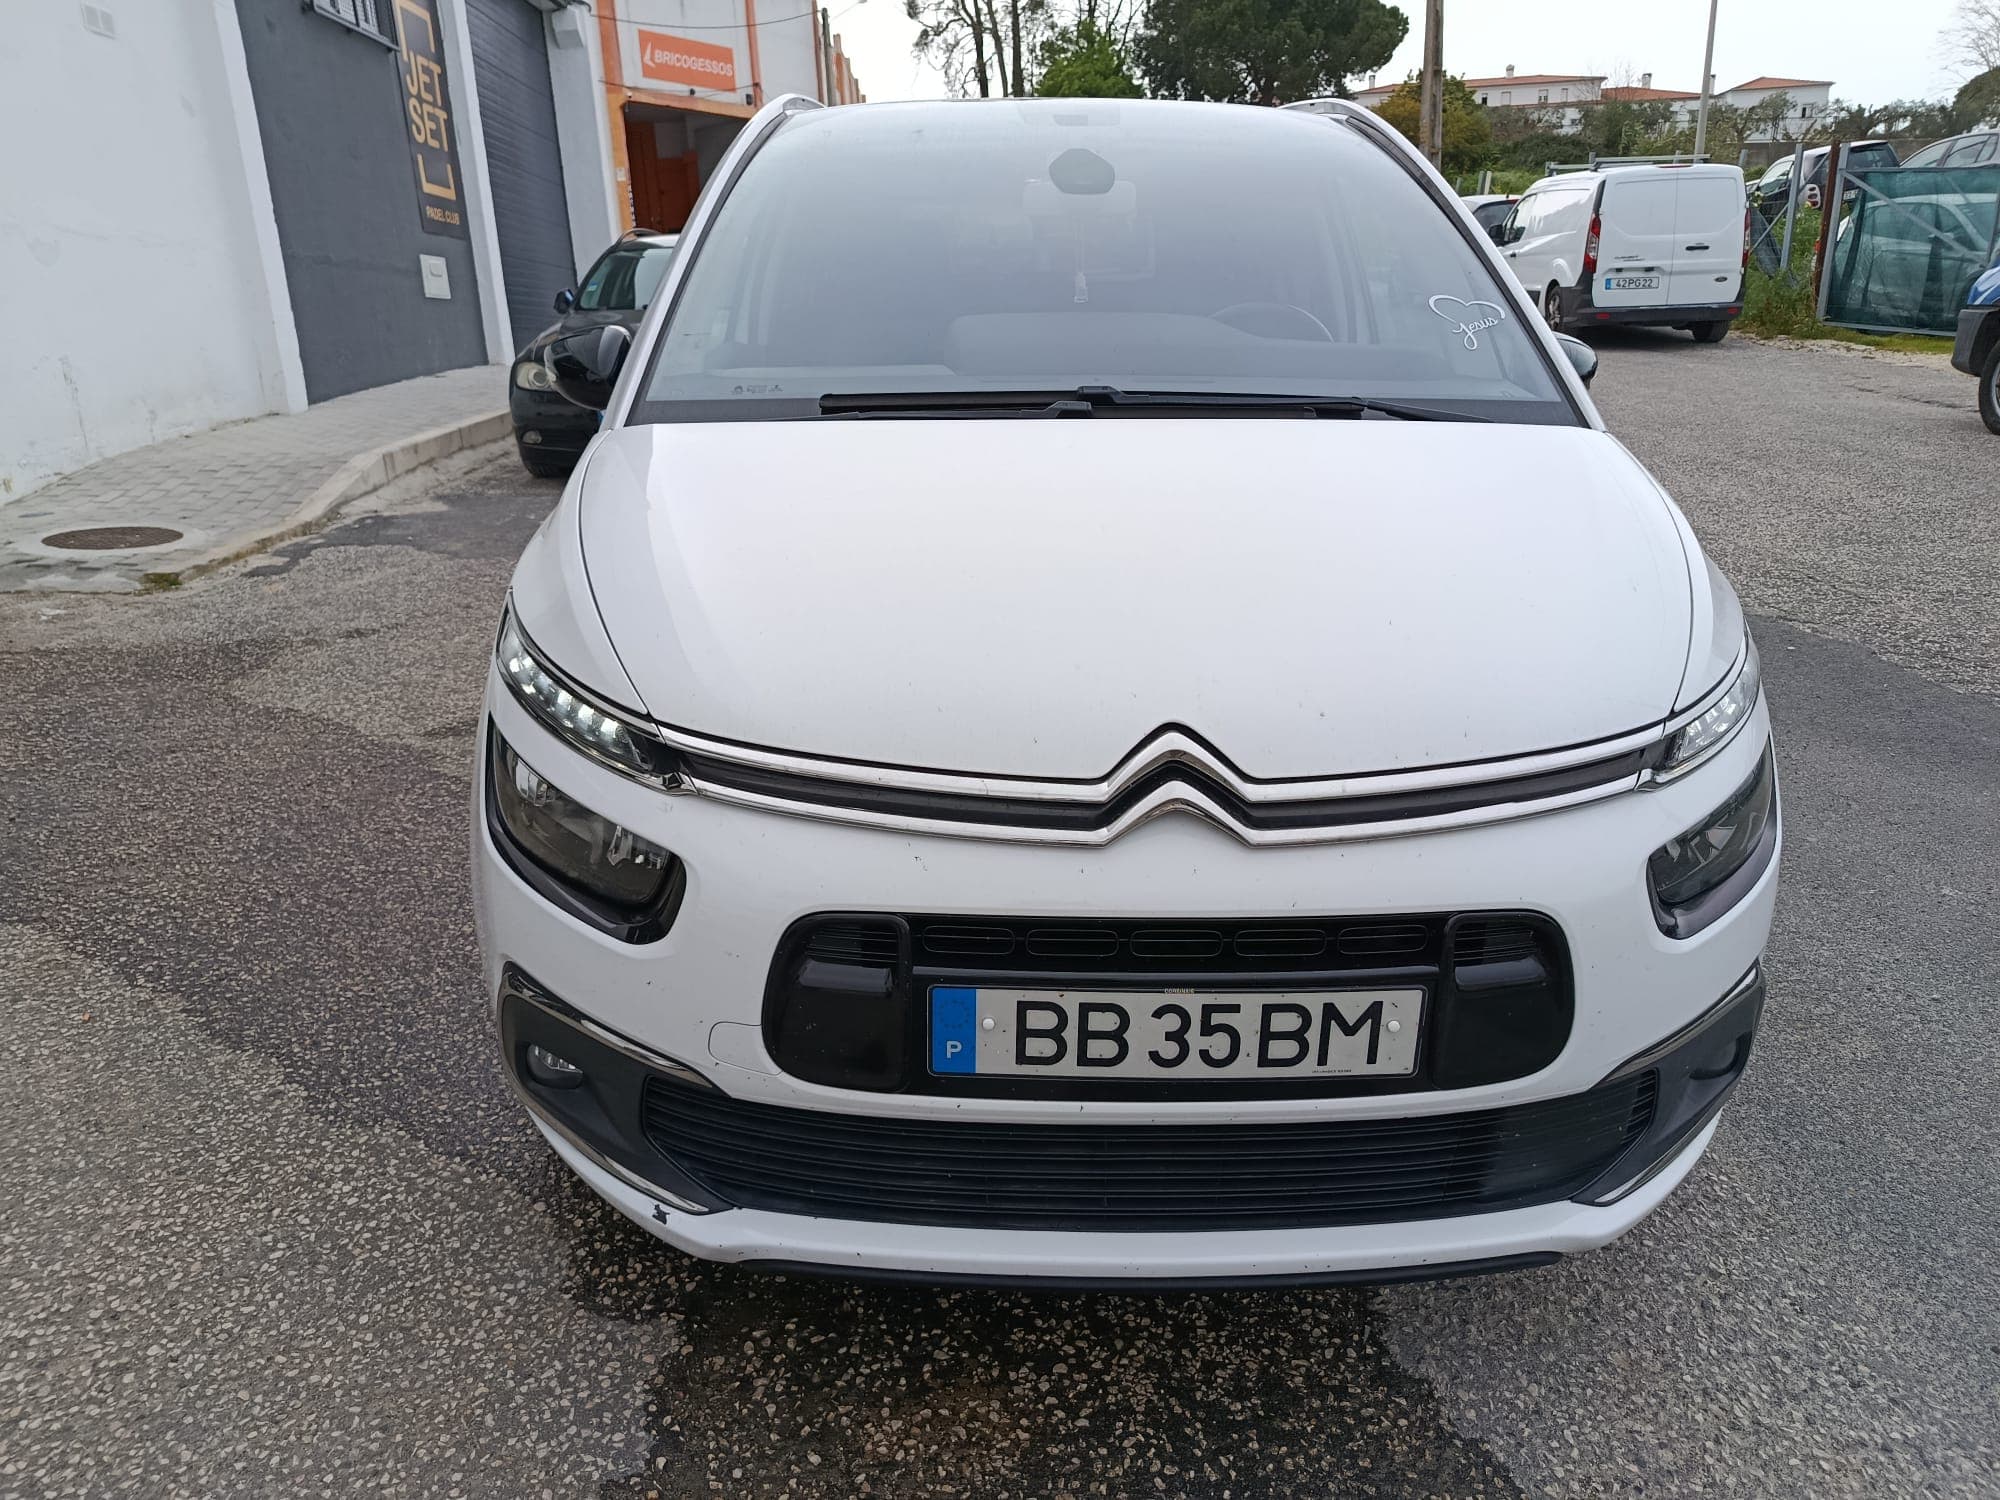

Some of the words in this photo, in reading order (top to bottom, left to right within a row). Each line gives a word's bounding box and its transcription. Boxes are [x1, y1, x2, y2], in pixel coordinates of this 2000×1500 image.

[406, 50, 442, 106] JET
[654, 48, 733, 77] BRICOGESSOS
[408, 97, 449, 152] SET
[426, 205, 445, 221] PADEL
[946, 1040, 962, 1058] P
[1015, 1000, 1131, 1067] BB
[1147, 1003, 1242, 1068] 35
[1257, 1000, 1384, 1068] BM
